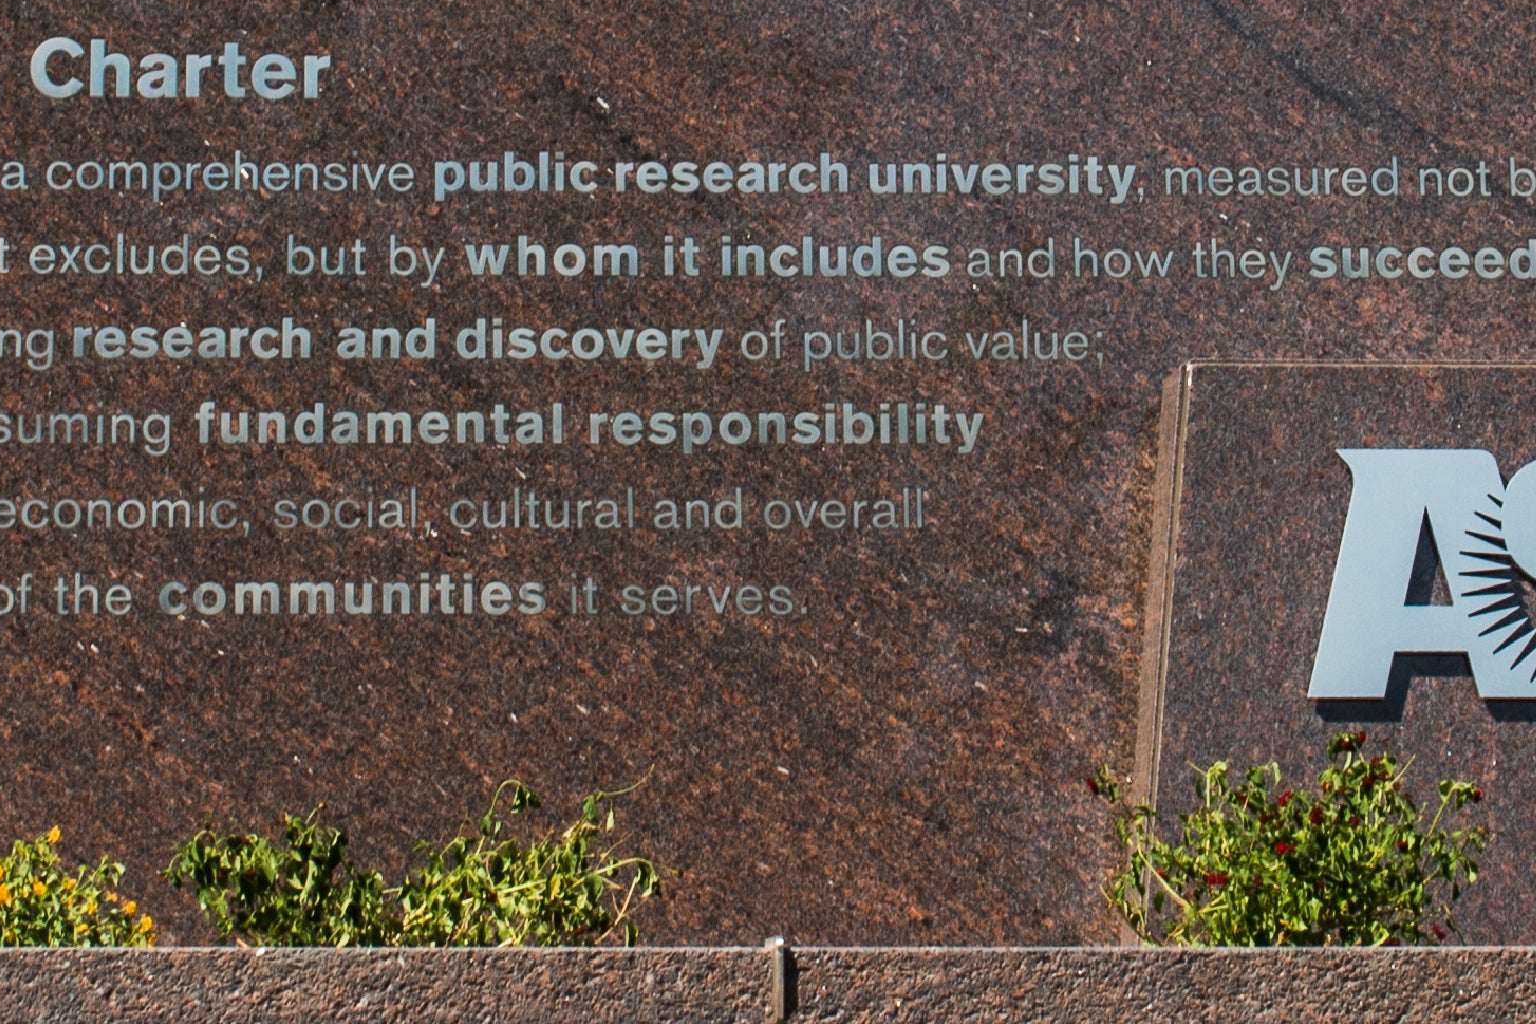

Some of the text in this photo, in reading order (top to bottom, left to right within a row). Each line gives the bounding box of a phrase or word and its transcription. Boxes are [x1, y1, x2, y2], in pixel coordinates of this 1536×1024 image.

[31, 37, 330, 99] Charter
[1, 162, 28, 189] a
[47, 150, 414, 202] comprehensive
[435, 152, 597, 201] public
[616, 153, 847, 193] research
[870, 154, 1143, 203] university,
[1165, 157, 1398, 196] measured
[1420, 161, 1491, 196] not
[30, 233, 262, 280] excludes,
[288, 235, 366, 275] but
[390, 235, 444, 287] by
[465, 236, 637, 276] whom
[665, 234, 700, 275] it
[722, 236, 949, 277] includes
[968, 238, 1054, 277] and
[1075, 238, 1173, 277] how
[1193, 238, 1291, 290] they
[74, 318, 310, 358] research
[337, 318, 435, 358] and
[457, 318, 723, 368] discovery
[741, 319, 785, 359] of
[805, 319, 947, 371] public
[966, 319, 1105, 367] value;
[198, 402, 562, 444] fundamental
[590, 403, 983, 453] responsibility
[275, 487, 434, 537] social,
[450, 487, 633, 529] cultural
[654, 487, 742, 528] and
[765, 487, 922, 529] overall
[54, 573, 131, 614] the
[160, 573, 544, 614] communities
[572, 573, 597, 613] it
[622, 573, 806, 615] serves.
